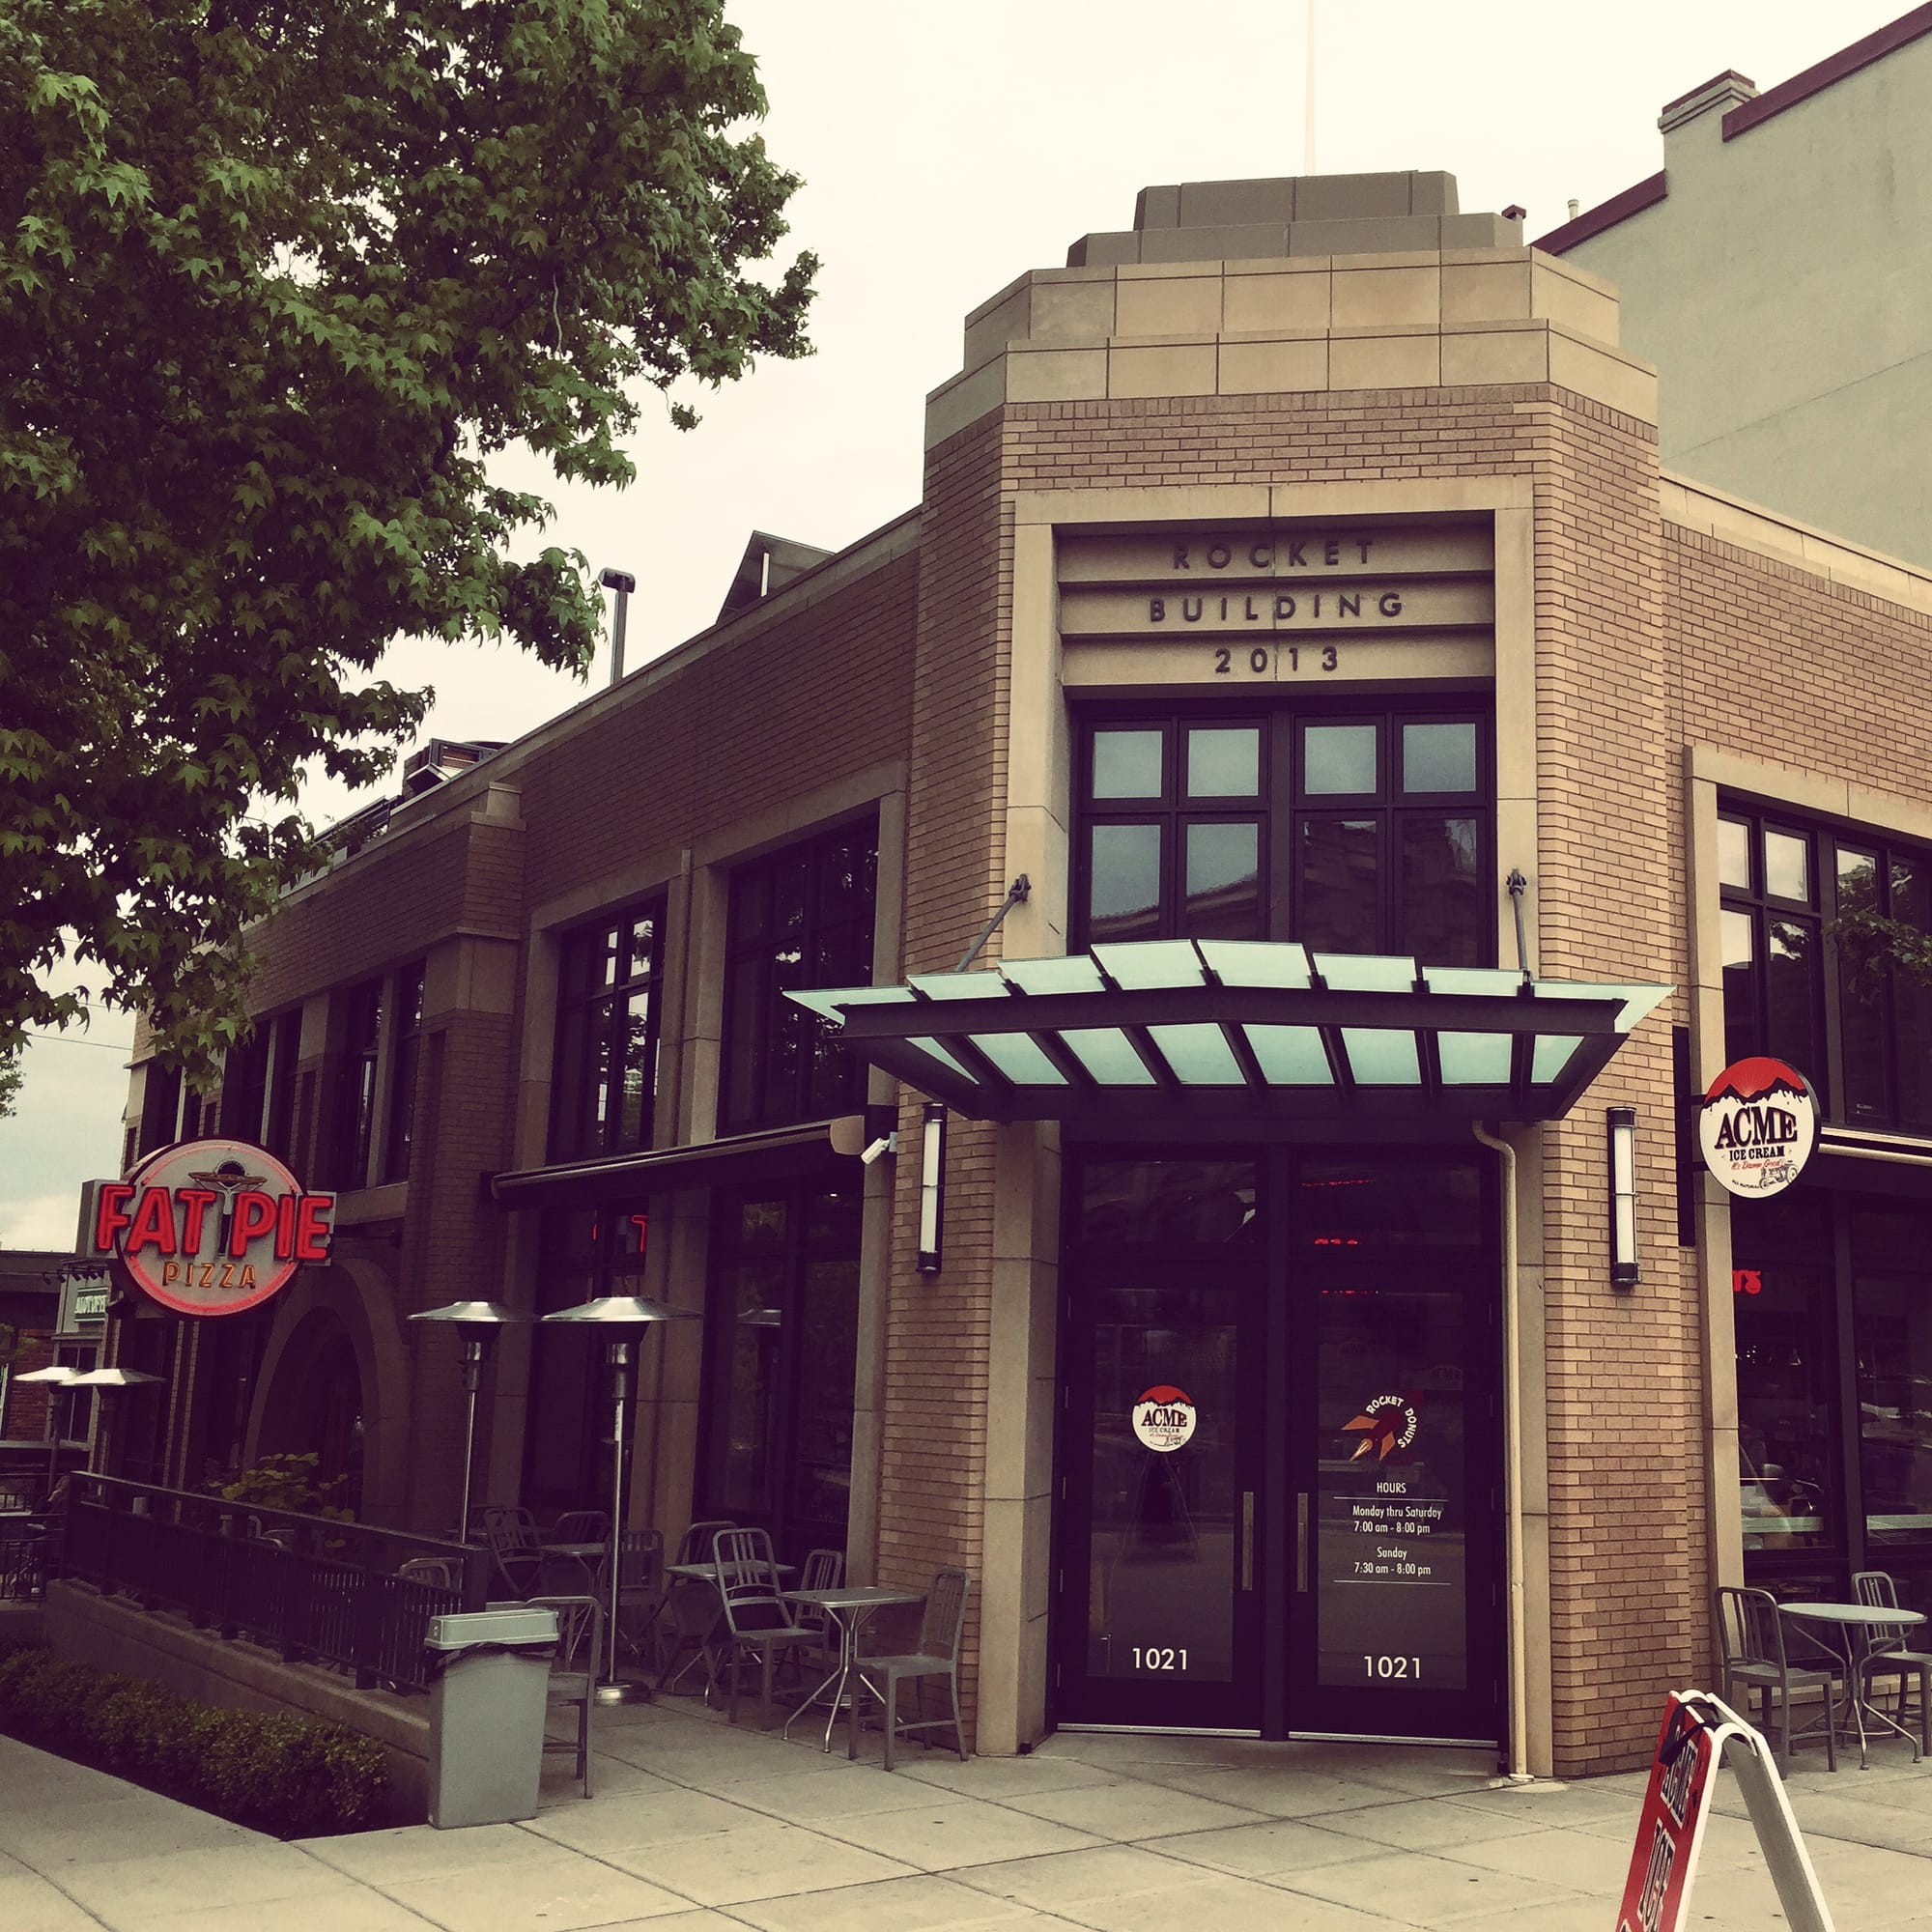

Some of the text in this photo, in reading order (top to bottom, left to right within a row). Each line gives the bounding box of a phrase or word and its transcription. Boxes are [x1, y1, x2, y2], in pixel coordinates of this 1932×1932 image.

[1173, 538, 1373, 570] ROCKET
[1150, 591, 1405, 622] BUILDING
[1214, 645, 1338, 674] 2013
[1714, 1106, 1798, 1150] ACME
[1729, 1145, 1785, 1161] ICE CREAM
[97, 1183, 334, 1261] FAT PIE
[162, 1261, 256, 1289] PIZZA
[1141, 1408, 1187, 1427] ACME
[1366, 1395, 1417, 1448] ROCKET DONUTS
[1377, 1482, 1406, 1493] HOURS
[1352, 1505, 1441, 1520] Monday thru Saturday
[1353, 1520, 1374, 1532] 7:00
[1375, 1523, 1388, 1533] am
[1396, 1521, 1415, 1534] 8:00
[1417, 1524, 1431, 1536] pm
[1377, 1547, 1407, 1559] Sunday
[1354, 1562, 1374, 1574] 7:30
[1376, 1564, 1389, 1574] am
[1396, 1563, 1416, 1575] 8:00
[1417, 1565, 1432, 1577] pm
[1132, 1647, 1188, 1670] 1021
[1363, 1656, 1421, 1679] 1021
